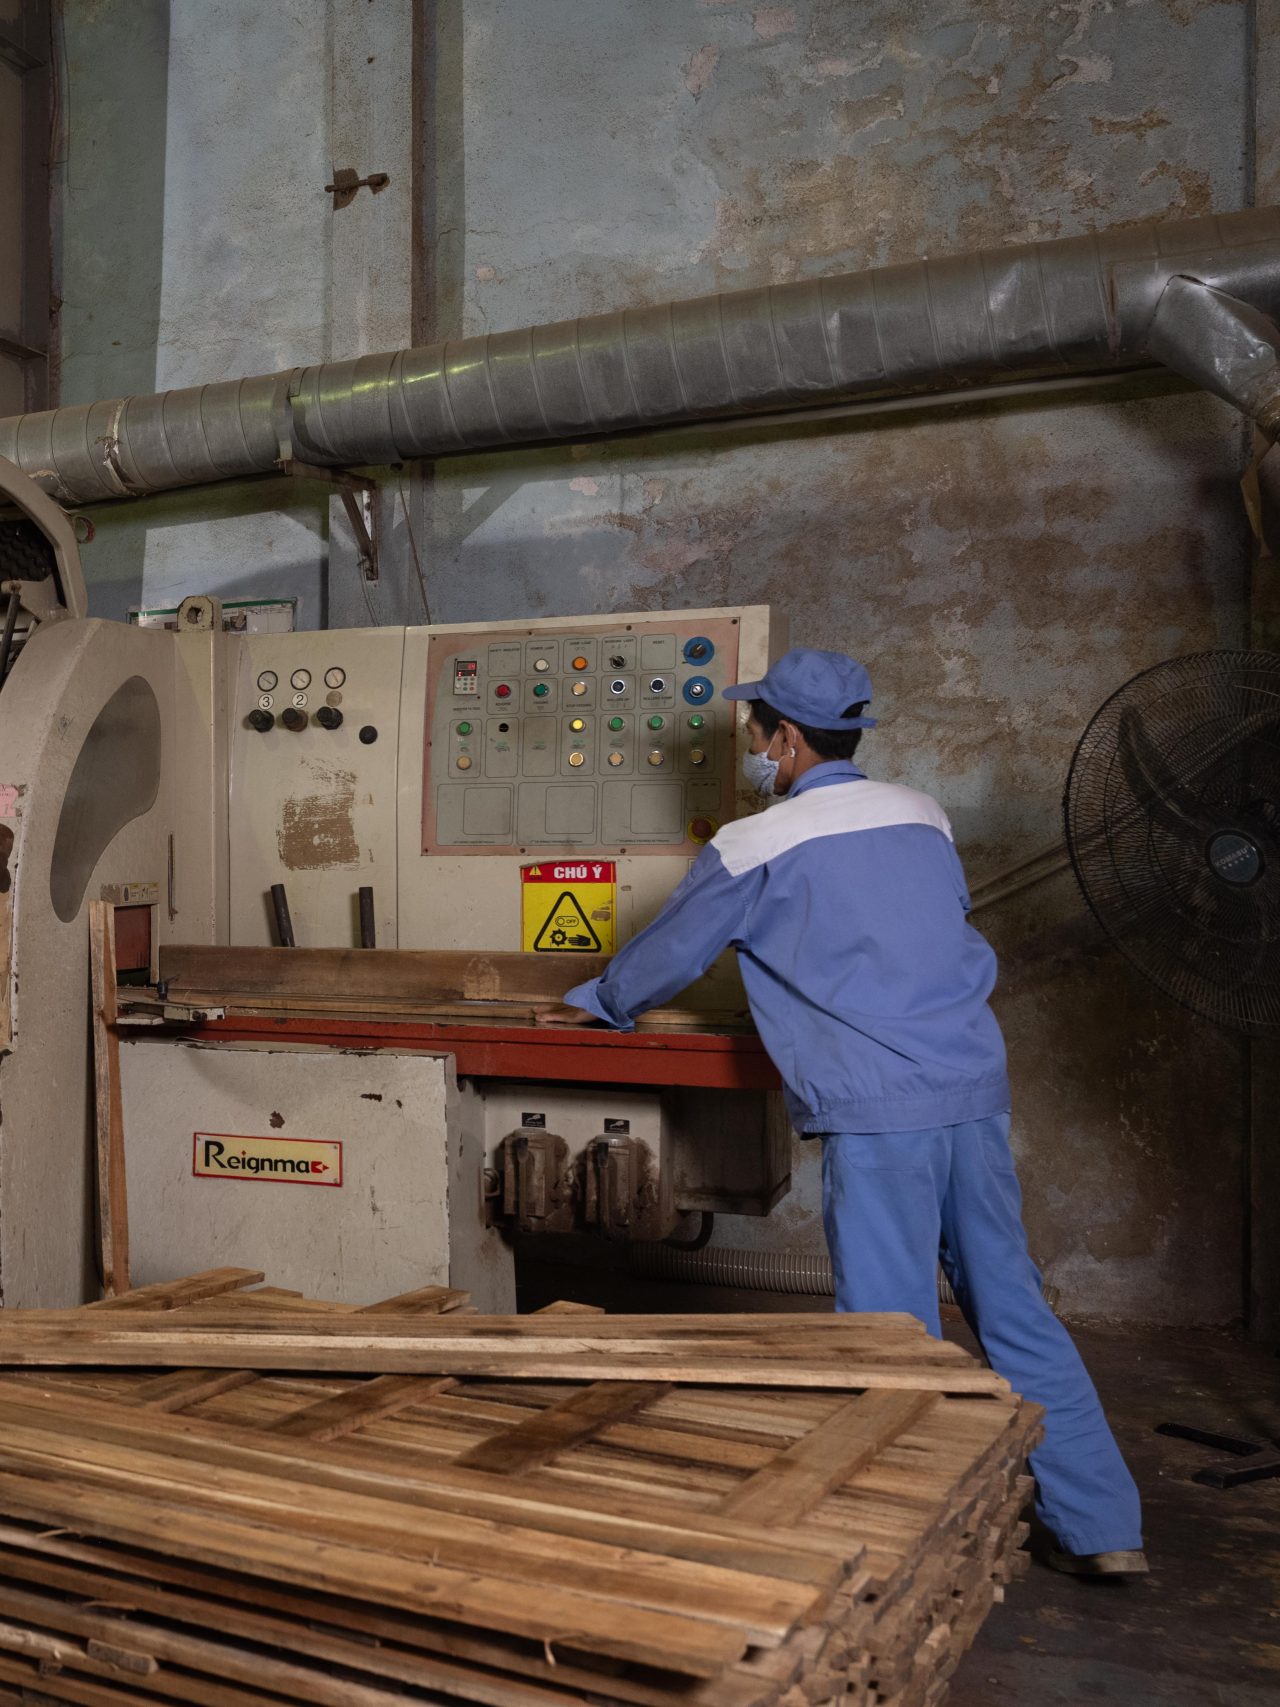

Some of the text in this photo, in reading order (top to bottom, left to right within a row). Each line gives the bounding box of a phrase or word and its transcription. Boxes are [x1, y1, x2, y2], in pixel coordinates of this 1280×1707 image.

[262, 697, 270, 707] 3
[296, 695, 303, 705] 2
[554, 865, 603, 879] CHÚ Ý
